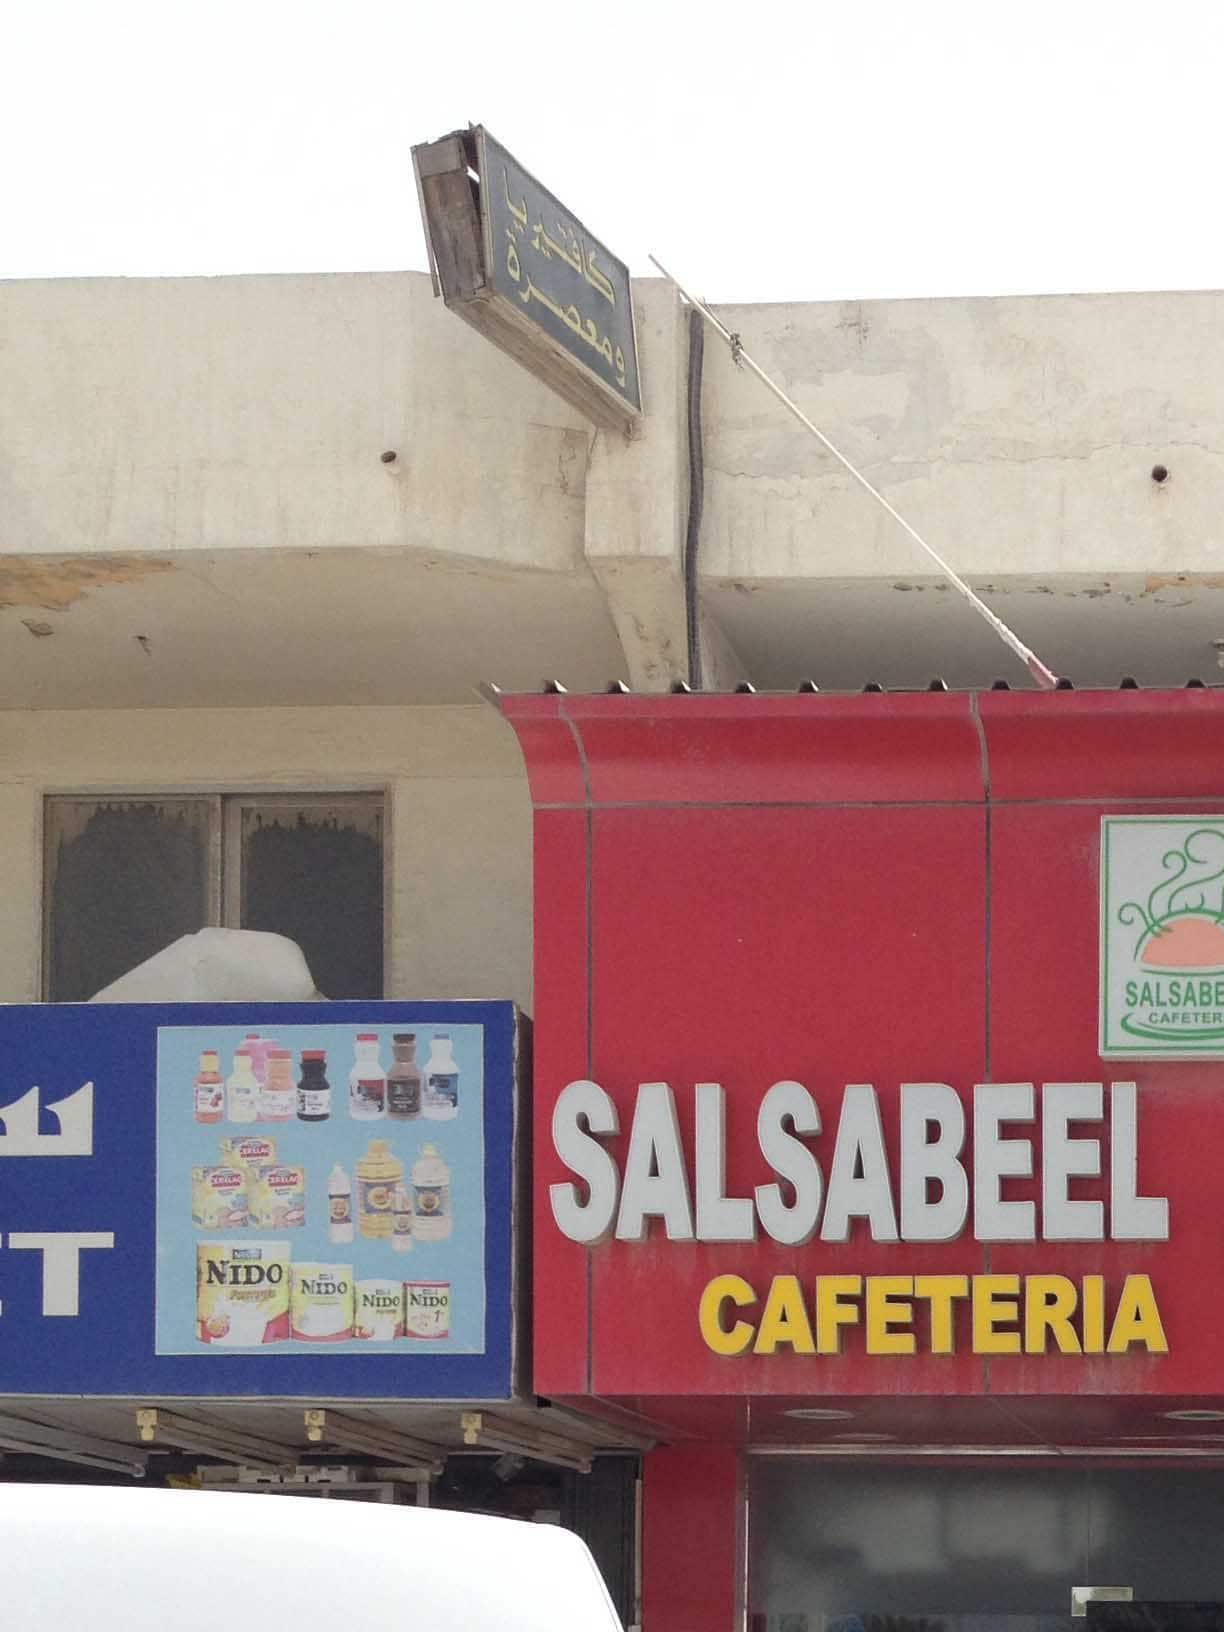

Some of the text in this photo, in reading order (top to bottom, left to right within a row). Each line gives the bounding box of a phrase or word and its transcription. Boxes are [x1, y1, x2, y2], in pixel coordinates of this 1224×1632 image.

[548, 1079, 1169, 1245] SALSABEEL
[0, 1231, 115, 1317] T
[206, 1260, 283, 1285] NIDO
[301, 1280, 348, 1296] NIDO
[409, 1293, 448, 1307] NIDO
[362, 1294, 400, 1308] NIDO
[698, 1273, 1169, 1355] CAFETERIA
